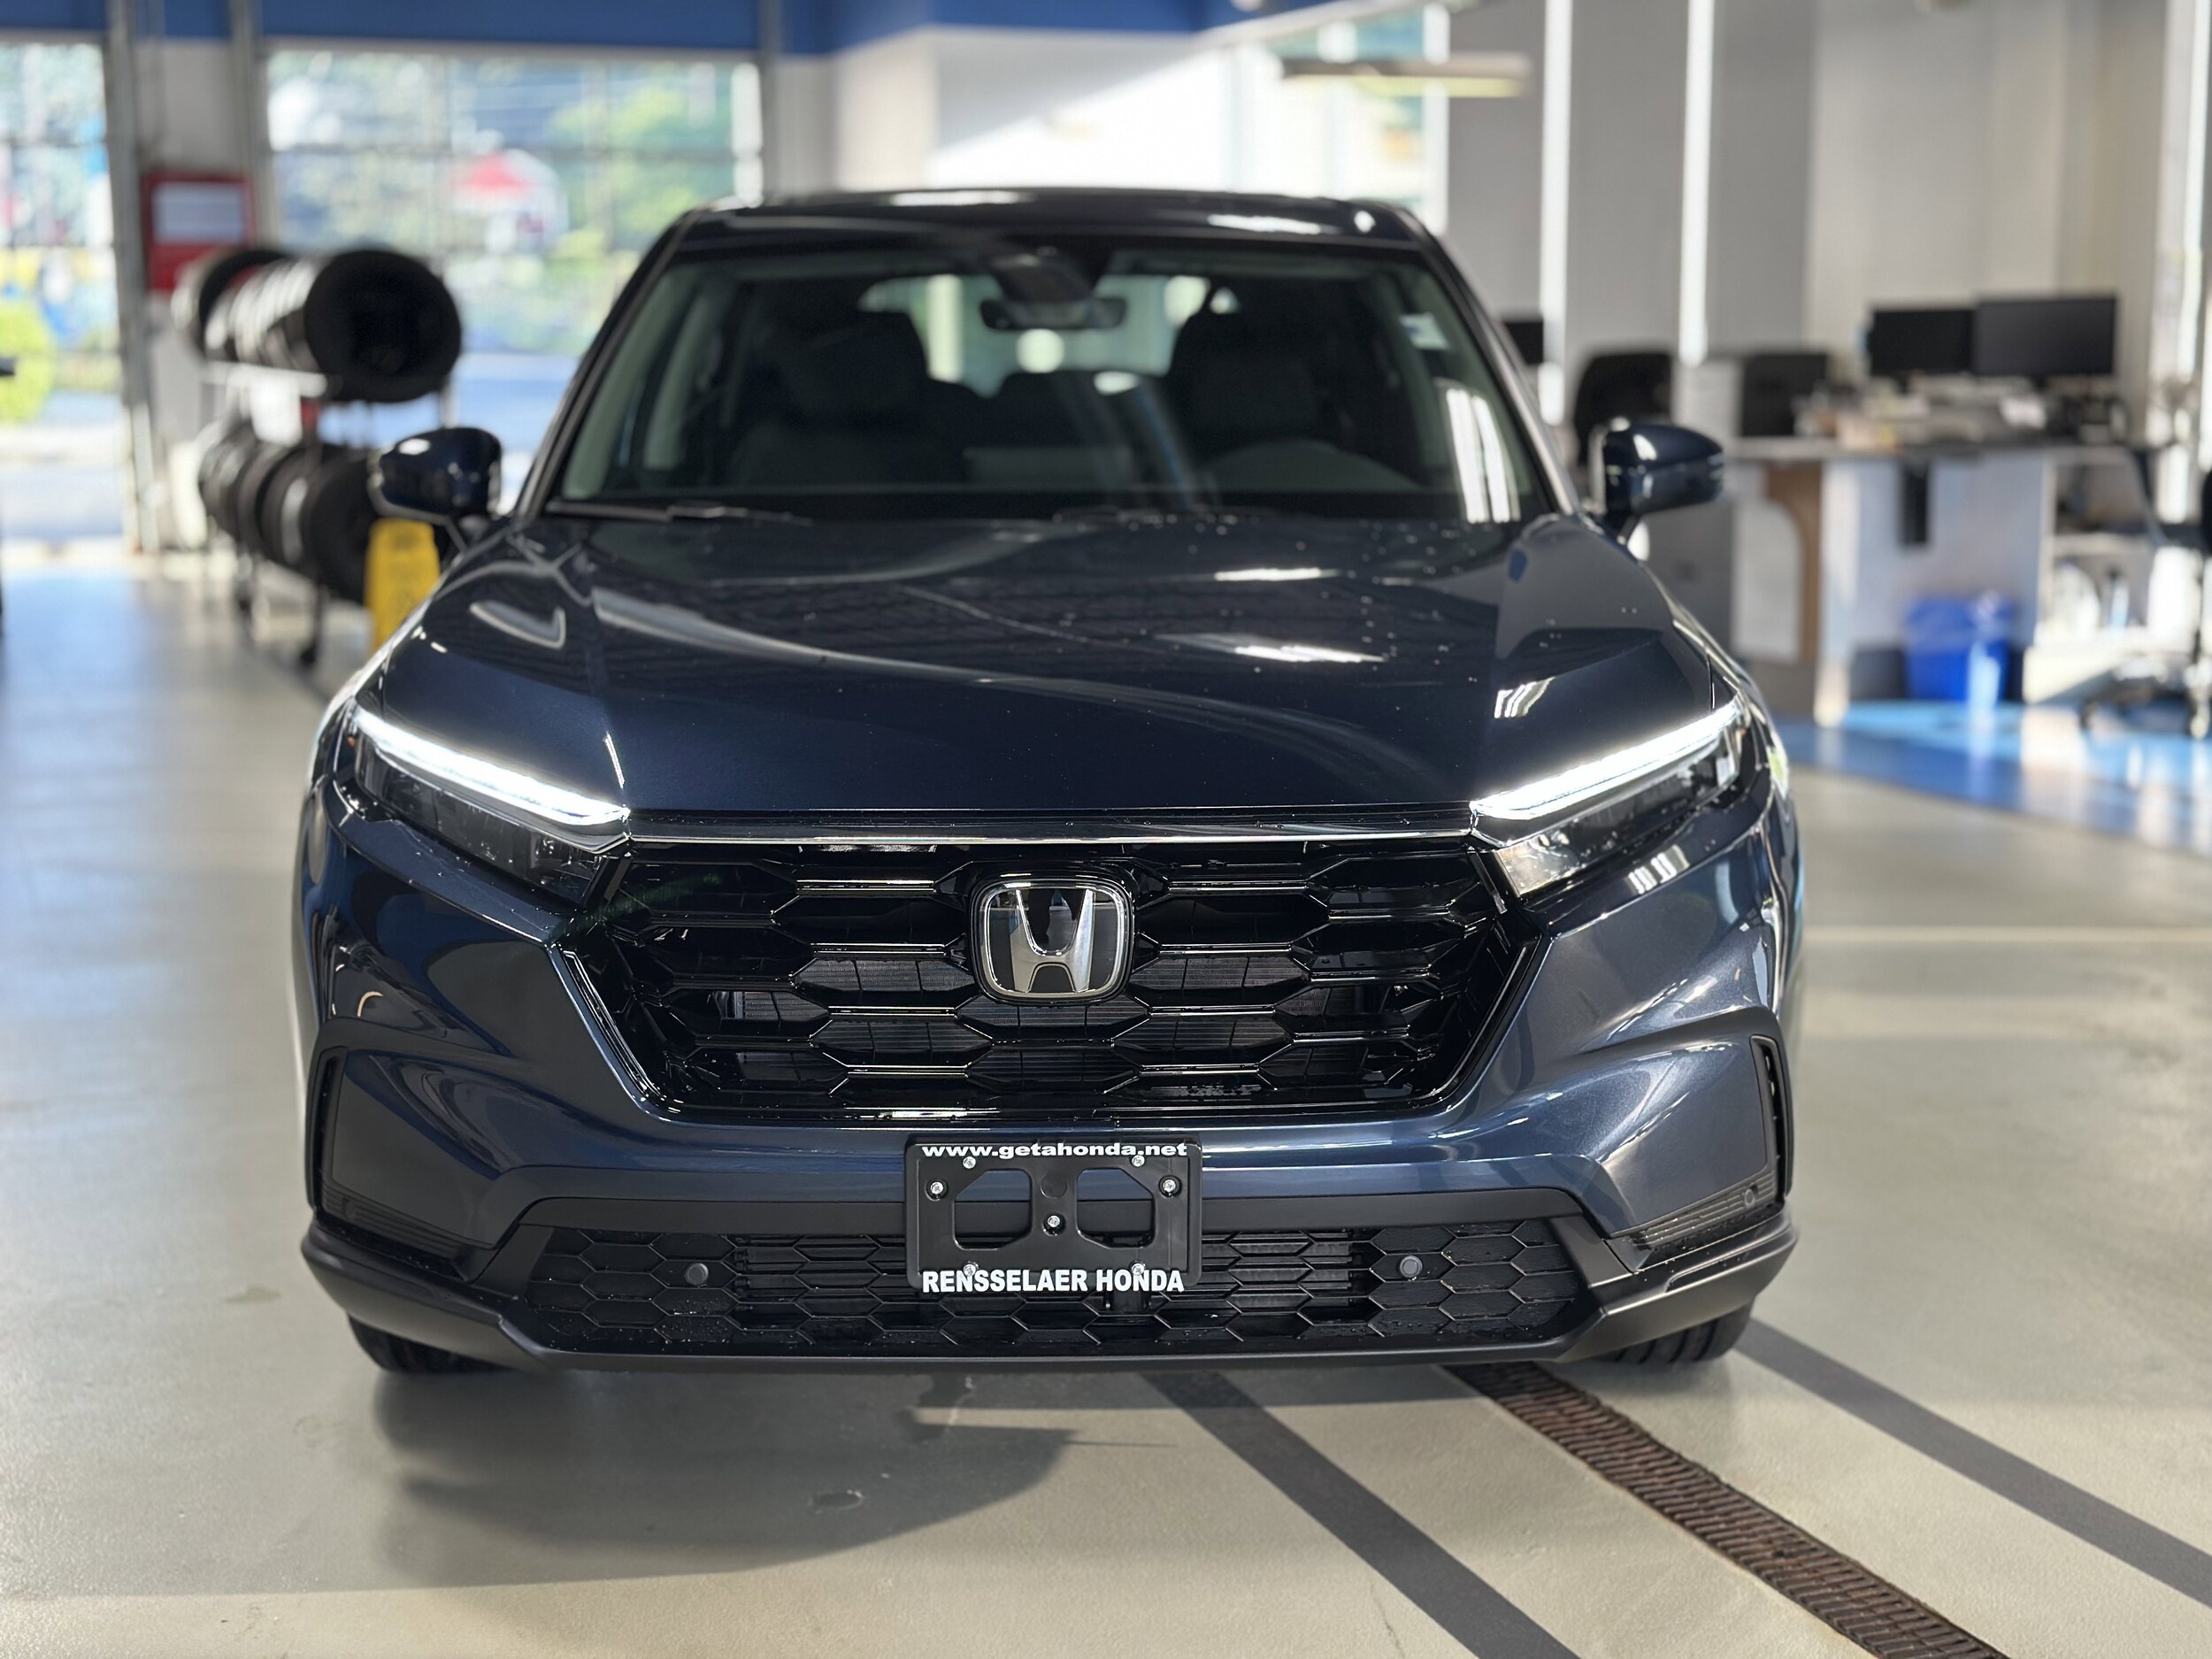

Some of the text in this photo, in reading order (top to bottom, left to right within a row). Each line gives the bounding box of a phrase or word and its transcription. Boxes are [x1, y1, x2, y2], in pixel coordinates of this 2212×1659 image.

[921, 1142, 1187, 1160] www.getahonda.net
[922, 1269, 1186, 1294] RENSSELAER HONDA
